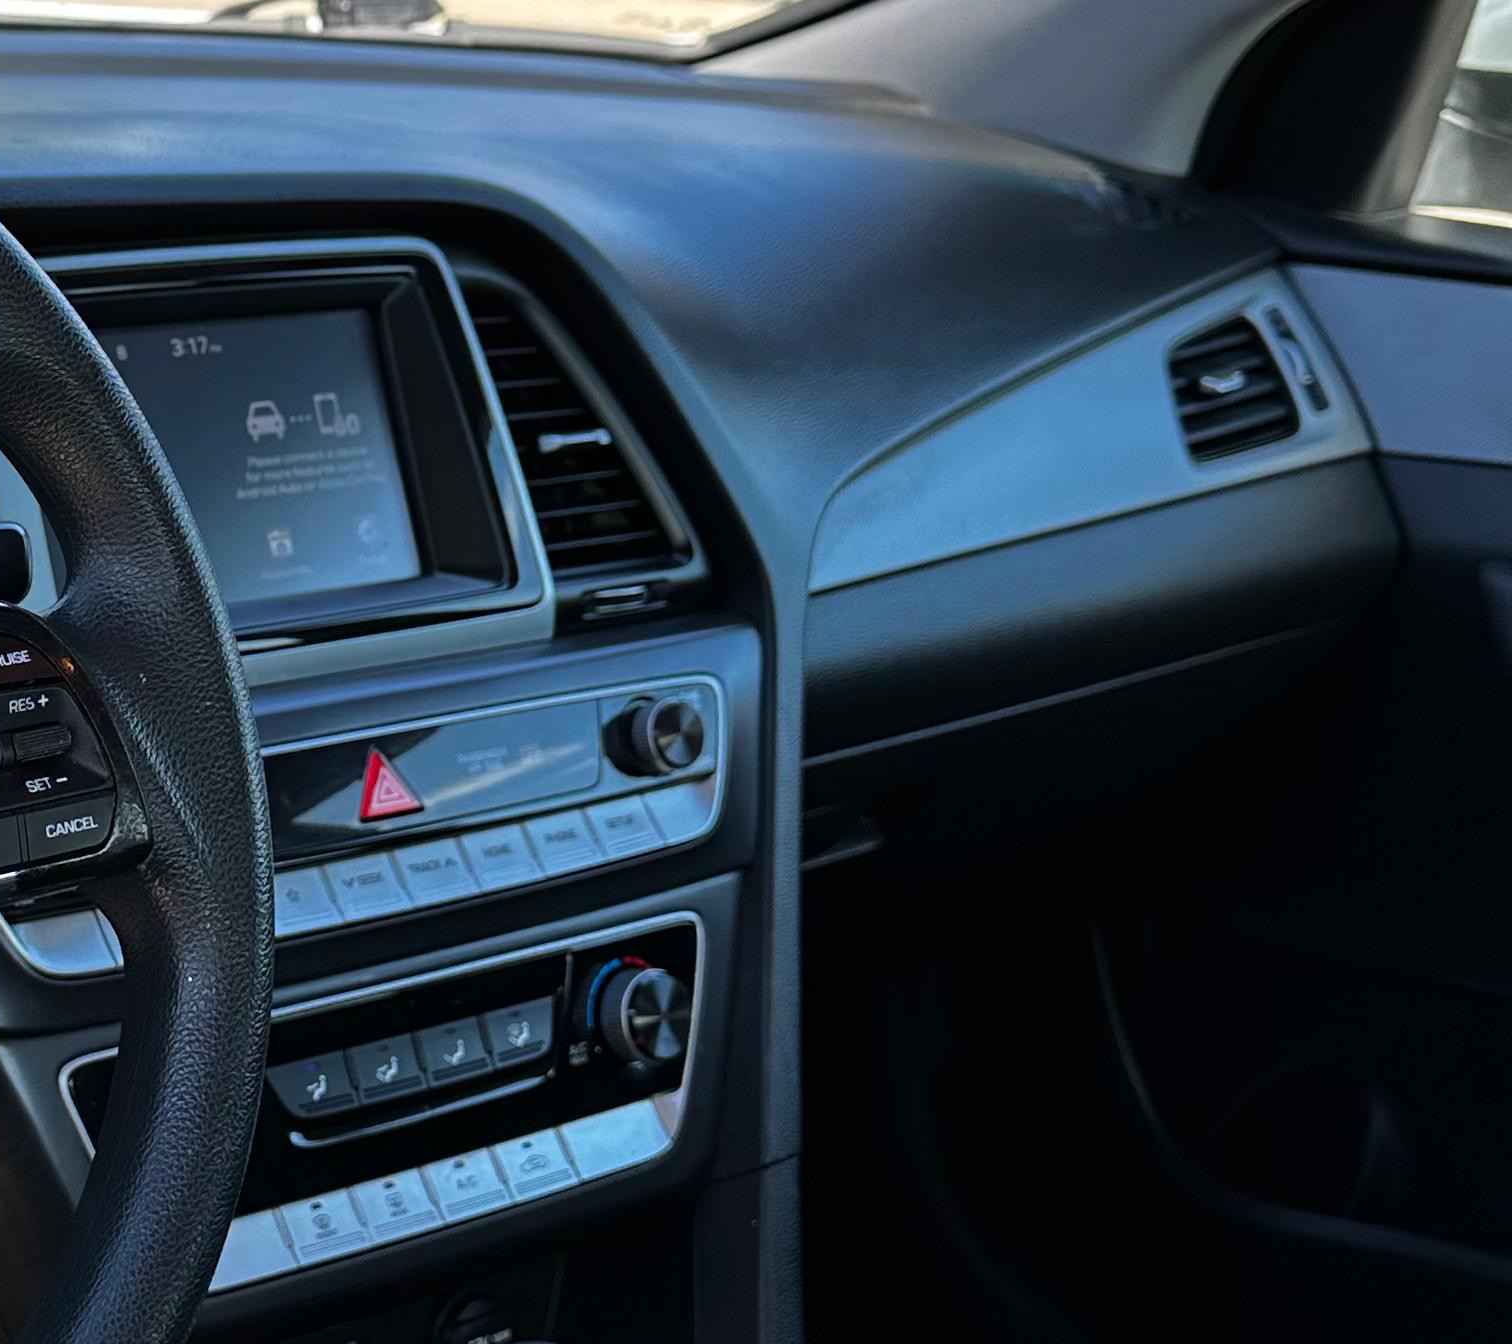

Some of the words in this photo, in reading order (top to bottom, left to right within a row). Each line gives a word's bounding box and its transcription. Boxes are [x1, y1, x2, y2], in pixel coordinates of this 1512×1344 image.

[9, 697, 35, 714] RES
[26, 777, 51, 793] SET
[45, 815, 99, 839] CANCEL
